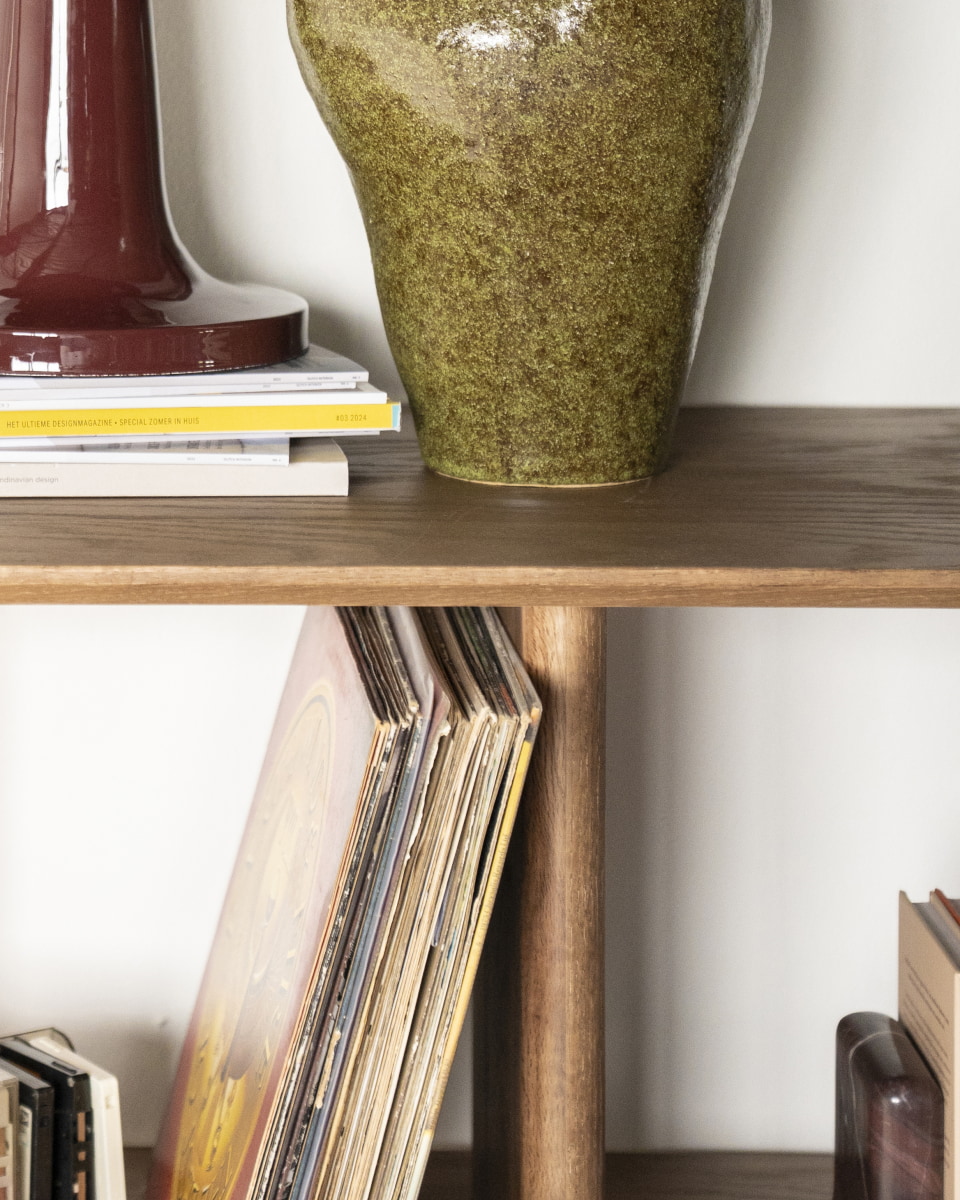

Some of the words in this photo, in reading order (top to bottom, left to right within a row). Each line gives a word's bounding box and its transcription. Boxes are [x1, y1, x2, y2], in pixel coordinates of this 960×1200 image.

[350, 413, 368, 422] 2024
[6, 420, 19, 429] HET
[21, 420, 50, 429] ULTIEME
[52, 419, 113, 428] DESIGNMAGAZINE
[119, 418, 147, 426] SPECIAL
[149, 417, 172, 425] ZOMER
[174, 417, 182, 425] IN
[183, 416, 201, 425] HUIS
[35, 476, 59, 485] design
